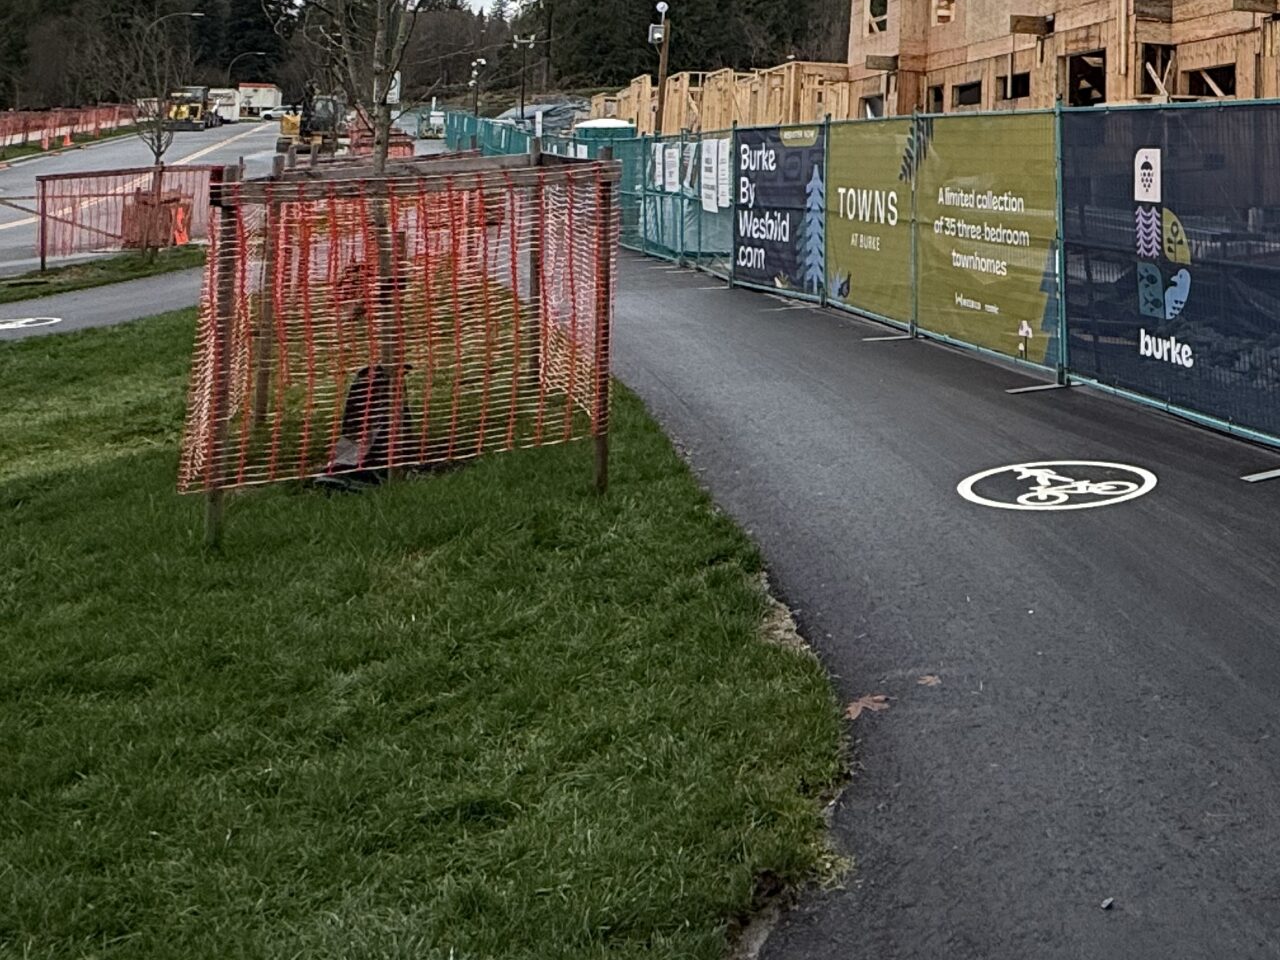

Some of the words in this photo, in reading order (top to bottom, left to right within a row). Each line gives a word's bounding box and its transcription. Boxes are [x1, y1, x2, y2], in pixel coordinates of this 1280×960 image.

[740, 142, 777, 171] Burke
[740, 176, 756, 208] By
[838, 187, 898, 226] TOWNS
[938, 187, 945, 204] A
[945, 187, 975, 208] limited
[976, 190, 1025, 213] collection
[738, 210, 790, 242] Wesbild
[934, 216, 943, 234] of
[944, 217, 956, 237] 35
[957, 219, 1030, 247] three-bedroom
[736, 245, 766, 270] .com
[859, 234, 880, 251] BURKE
[952, 248, 1008, 276] townhomes
[1140, 328, 1194, 368] burke
